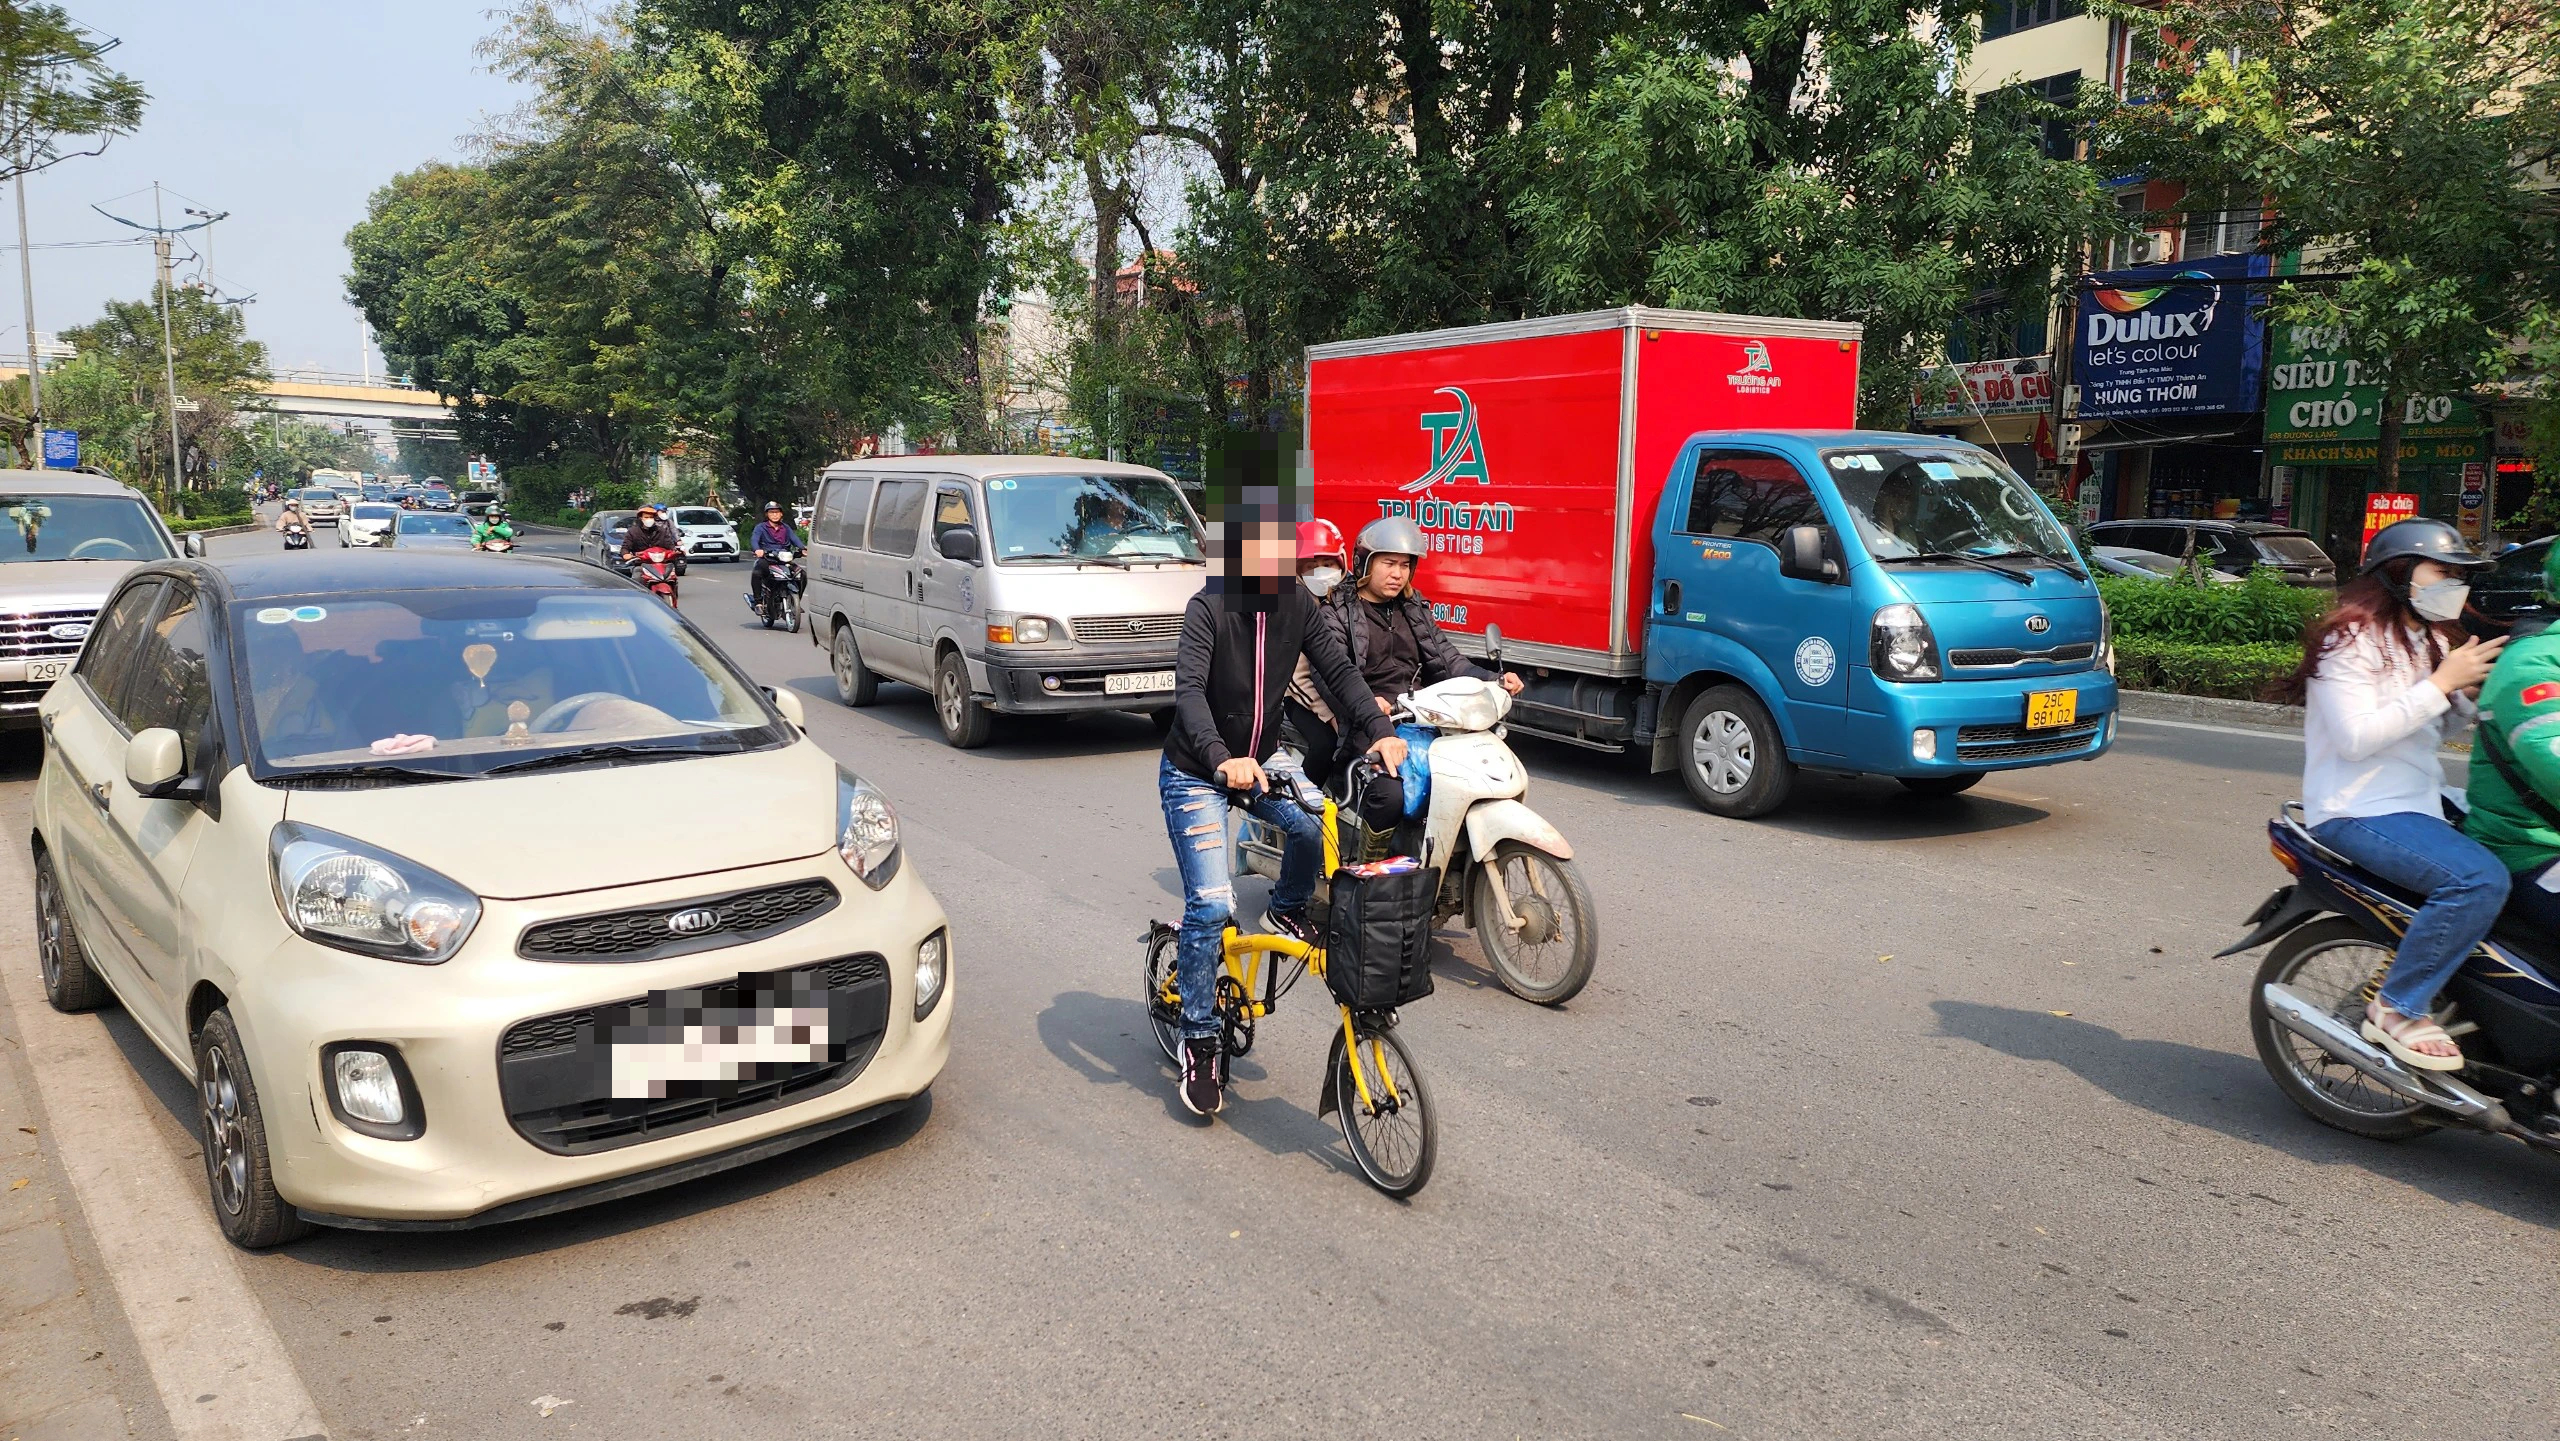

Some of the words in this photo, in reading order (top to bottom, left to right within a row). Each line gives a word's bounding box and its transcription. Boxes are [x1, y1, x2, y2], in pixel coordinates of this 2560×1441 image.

[2087, 310, 2199, 346] Dulux
[2089, 346, 2126, 366] let's
[2131, 343, 2202, 363] colour
[2272, 354, 2337, 391] SIÊU
[1736, 385, 1771, 394] LOGISTICS
[2094, 386, 2142, 405] HƯNG
[2146, 383, 2198, 402] THƠM
[2289, 391, 2357, 428] CHÓ
[2282, 443, 2339, 460] KHÁCH
[2342, 447, 2378, 462] SẠN
[2372, 494, 2390, 510] sửa
[2392, 495, 2414, 510] chữa
[2365, 512, 2378, 530] XE
[1702, 540, 1733, 549] FRONTIER
[1703, 548, 1732, 560] K200
[58, 626, 85, 637] Ford
[2030, 617, 2048, 631] KIA
[1108, 673, 1174, 692] 29D-221.48
[2043, 693, 2064, 709] 29C
[2033, 708, 2071, 727] 981.02
[677, 911, 716, 931] KIA
